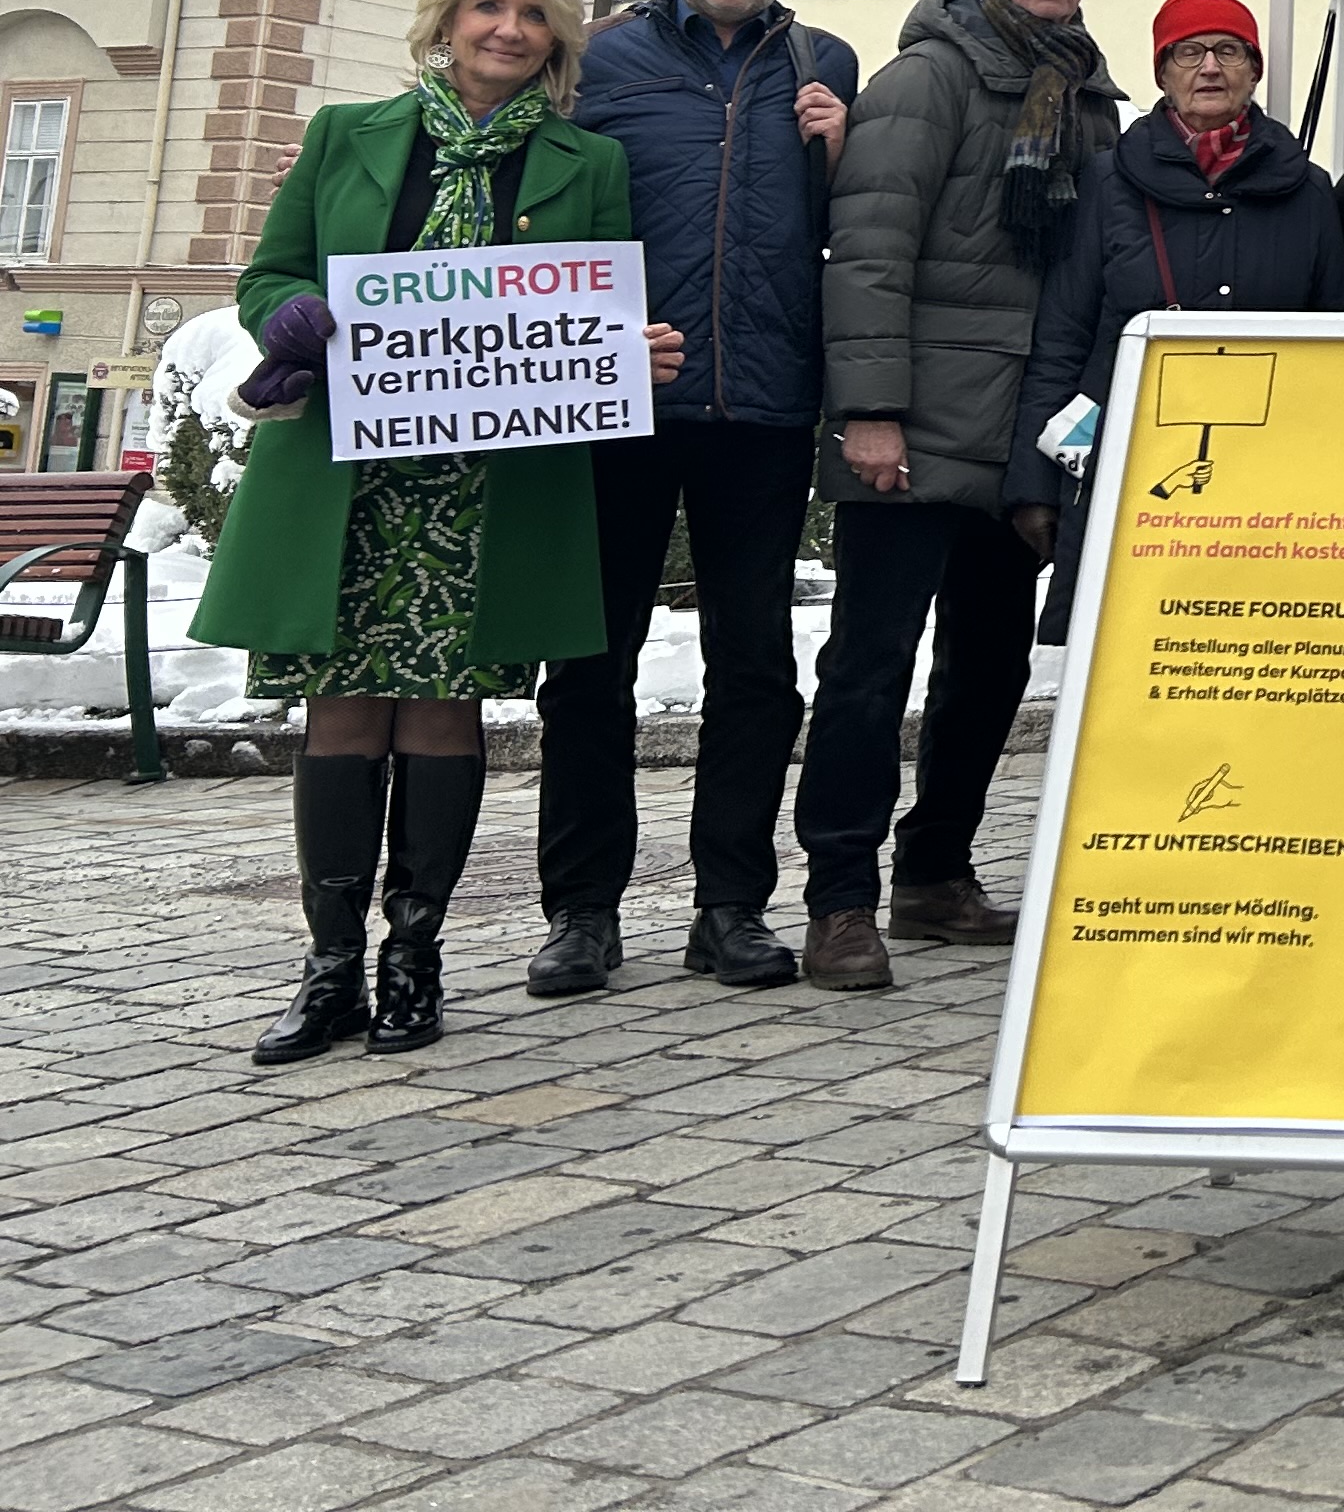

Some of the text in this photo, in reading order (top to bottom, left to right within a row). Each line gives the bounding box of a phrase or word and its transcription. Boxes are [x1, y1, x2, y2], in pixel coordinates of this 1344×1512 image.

[355, 260, 614, 307] GRÜNROTE
[350, 312, 624, 363] Parkplatz-
[351, 352, 618, 396] vernichtung
[354, 399, 631, 450] NEIN DANKE!
[1136, 512, 1242, 529] Parkraum
[1247, 512, 1294, 530] darf
[1131, 543, 1164, 558] um
[1168, 539, 1201, 558] ihn
[1206, 540, 1287, 560] danach
[1160, 599, 1246, 617] UNSERE
[1153, 637, 1250, 656] Einstellung
[1252, 639, 1292, 655] aller
[1149, 661, 1255, 680] Erweiterung
[1258, 664, 1288, 679] der
[1148, 685, 1161, 699] &
[1167, 685, 1219, 700] Erhalt
[1222, 687, 1252, 701] der
[1082, 832, 1152, 851] JETZT
[1073, 897, 1319, 922] Es geht um unser Mödling.
[1072, 925, 1314, 948] Zusammen sind wir mehr.
